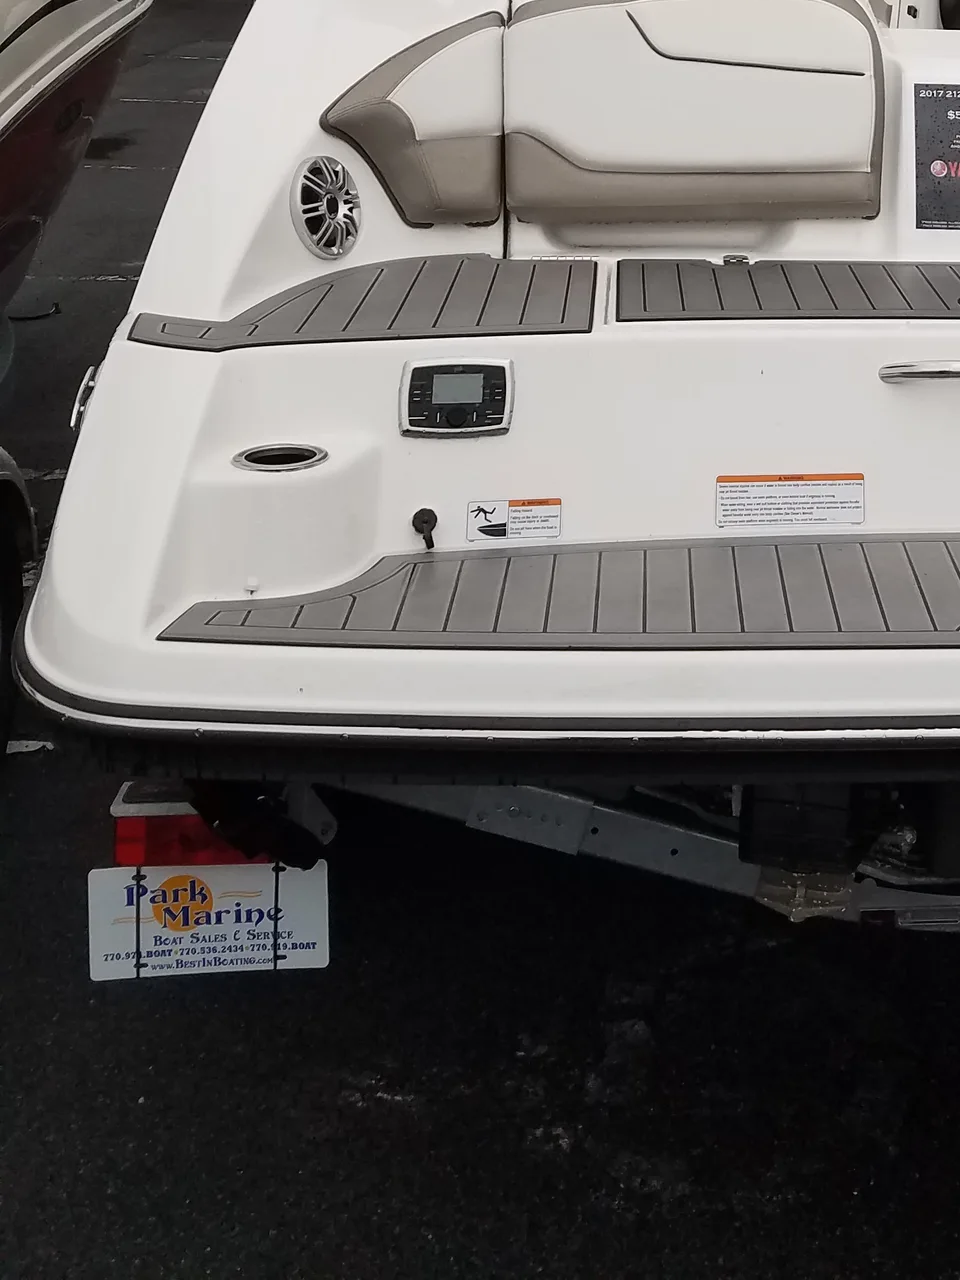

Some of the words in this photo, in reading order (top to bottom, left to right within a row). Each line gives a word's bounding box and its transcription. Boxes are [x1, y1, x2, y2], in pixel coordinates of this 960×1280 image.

[919, 89, 943, 98] 2017
[123, 879, 208, 907] Park
[161, 902, 285, 929] Marine
[102, 948, 173, 961] 770.97.BOAT
[178, 944, 244, 956] 770.536.2434
